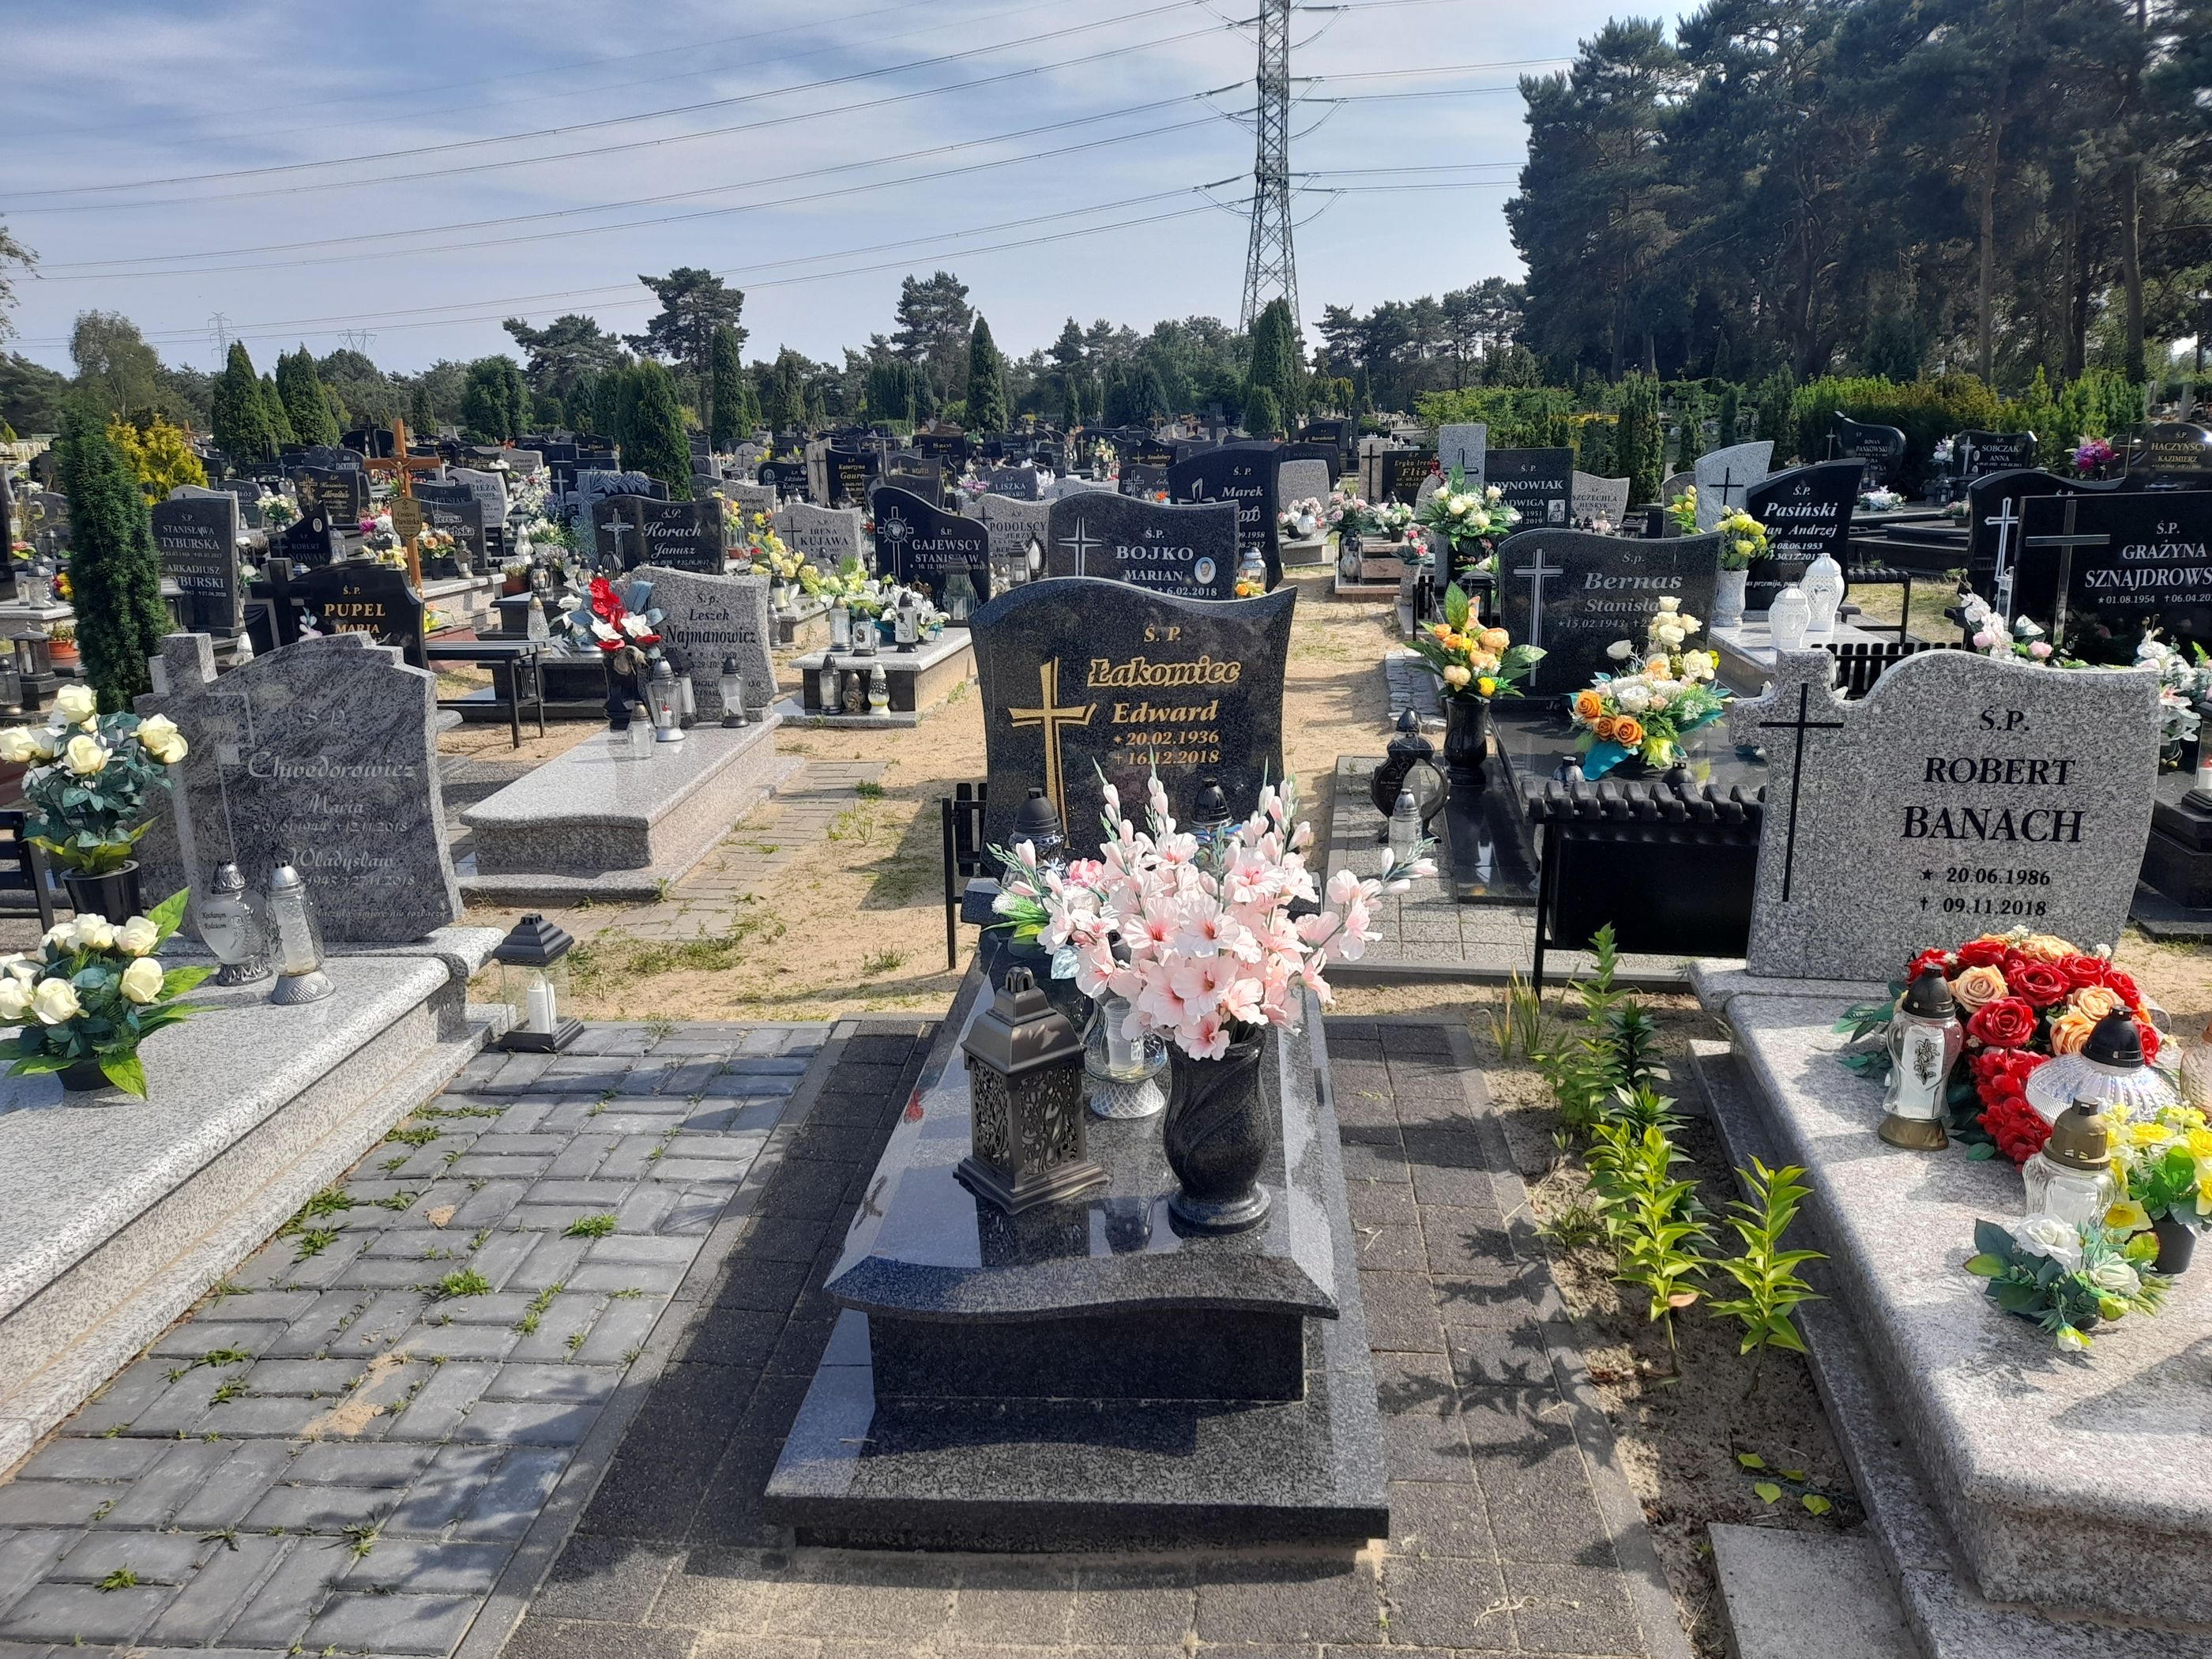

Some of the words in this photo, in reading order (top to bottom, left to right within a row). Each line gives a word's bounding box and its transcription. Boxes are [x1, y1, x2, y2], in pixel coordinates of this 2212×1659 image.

[1981, 444, 2020, 453] SOBCZAK
[2150, 441, 2208, 452] HACZYŃSCY
[2157, 454, 2199, 463] KAZIMIERZ
[1233, 465, 1242, 476] Ś.
[1244, 467, 1252, 476] P.
[1401, 468, 1428, 476] Flis
[1521, 464, 1528, 472] Ś.
[1221, 485, 1264, 498] Marek
[1793, 484, 1811, 496] Ś.P.
[1762, 502, 1839, 517] Pasiński
[641, 521, 702, 538] Korach
[989, 521, 1047, 532] PODOLSCY
[1146, 527, 1165, 540] Ś.P.
[1788, 524, 1838, 539] Andrzej
[2156, 519, 2181, 535] Ś.P.
[161, 537, 220, 550] TYBURSKA
[800, 536, 849, 546] KUJAWA
[912, 539, 982, 551] GAJEWSCY
[650, 543, 697, 559] Janusz
[1115, 545, 1194, 562] BOJKO
[2121, 539, 2209, 561] GRAŻYNA
[915, 553, 980, 563] STANISAW
[167, 564, 221, 574] ARKADIUSZ
[1123, 569, 1184, 581] MARIAN
[1582, 572, 1684, 590] Bernas
[343, 585, 351, 595] Ś.
[2105, 593, 2156, 604] 01.08.1954
[324, 604, 386, 618] PUPEL
[690, 609, 732, 622] Leszek
[335, 624, 380, 634] MARIA
[1143, 623, 1161, 642] Ś.
[1168, 626, 1183, 641] P.
[665, 625, 757, 650] Najmanowicz
[1087, 654, 1242, 687] Łakomiec
[1111, 699, 1220, 724] Edward
[1979, 705, 2031, 732] Ś.P.
[1125, 729, 1220, 747] 20.02.1936
[1127, 750, 1221, 766] 16.12.2018
[1923, 757, 2078, 785] ROBERT
[307, 794, 365, 816] Maria
[1900, 806, 2087, 843] BANACH
[1946, 867, 2052, 886] 20.06.1986
[1943, 897, 2047, 916] 09.11.2018
